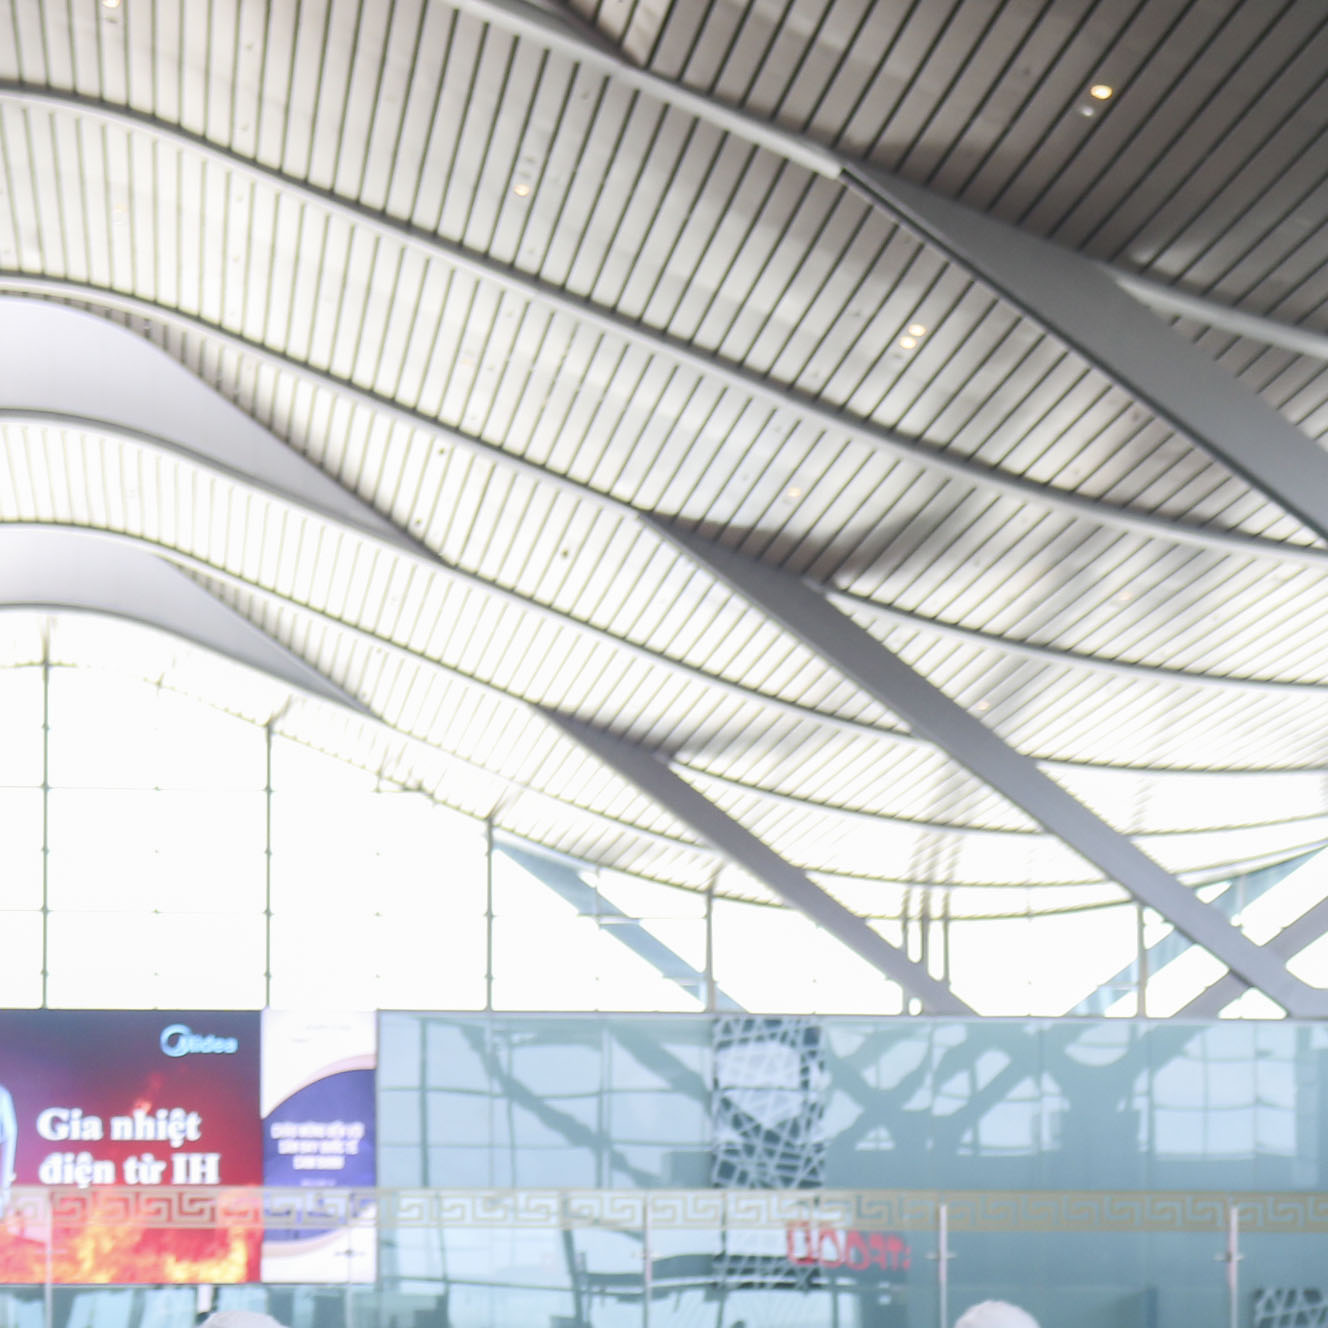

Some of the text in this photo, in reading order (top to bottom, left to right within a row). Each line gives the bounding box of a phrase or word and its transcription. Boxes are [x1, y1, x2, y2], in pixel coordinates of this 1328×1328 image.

[37, 1107, 202, 1148] Gia nhiệt
[39, 1151, 116, 1188] điện
[172, 1152, 221, 1185] IH
